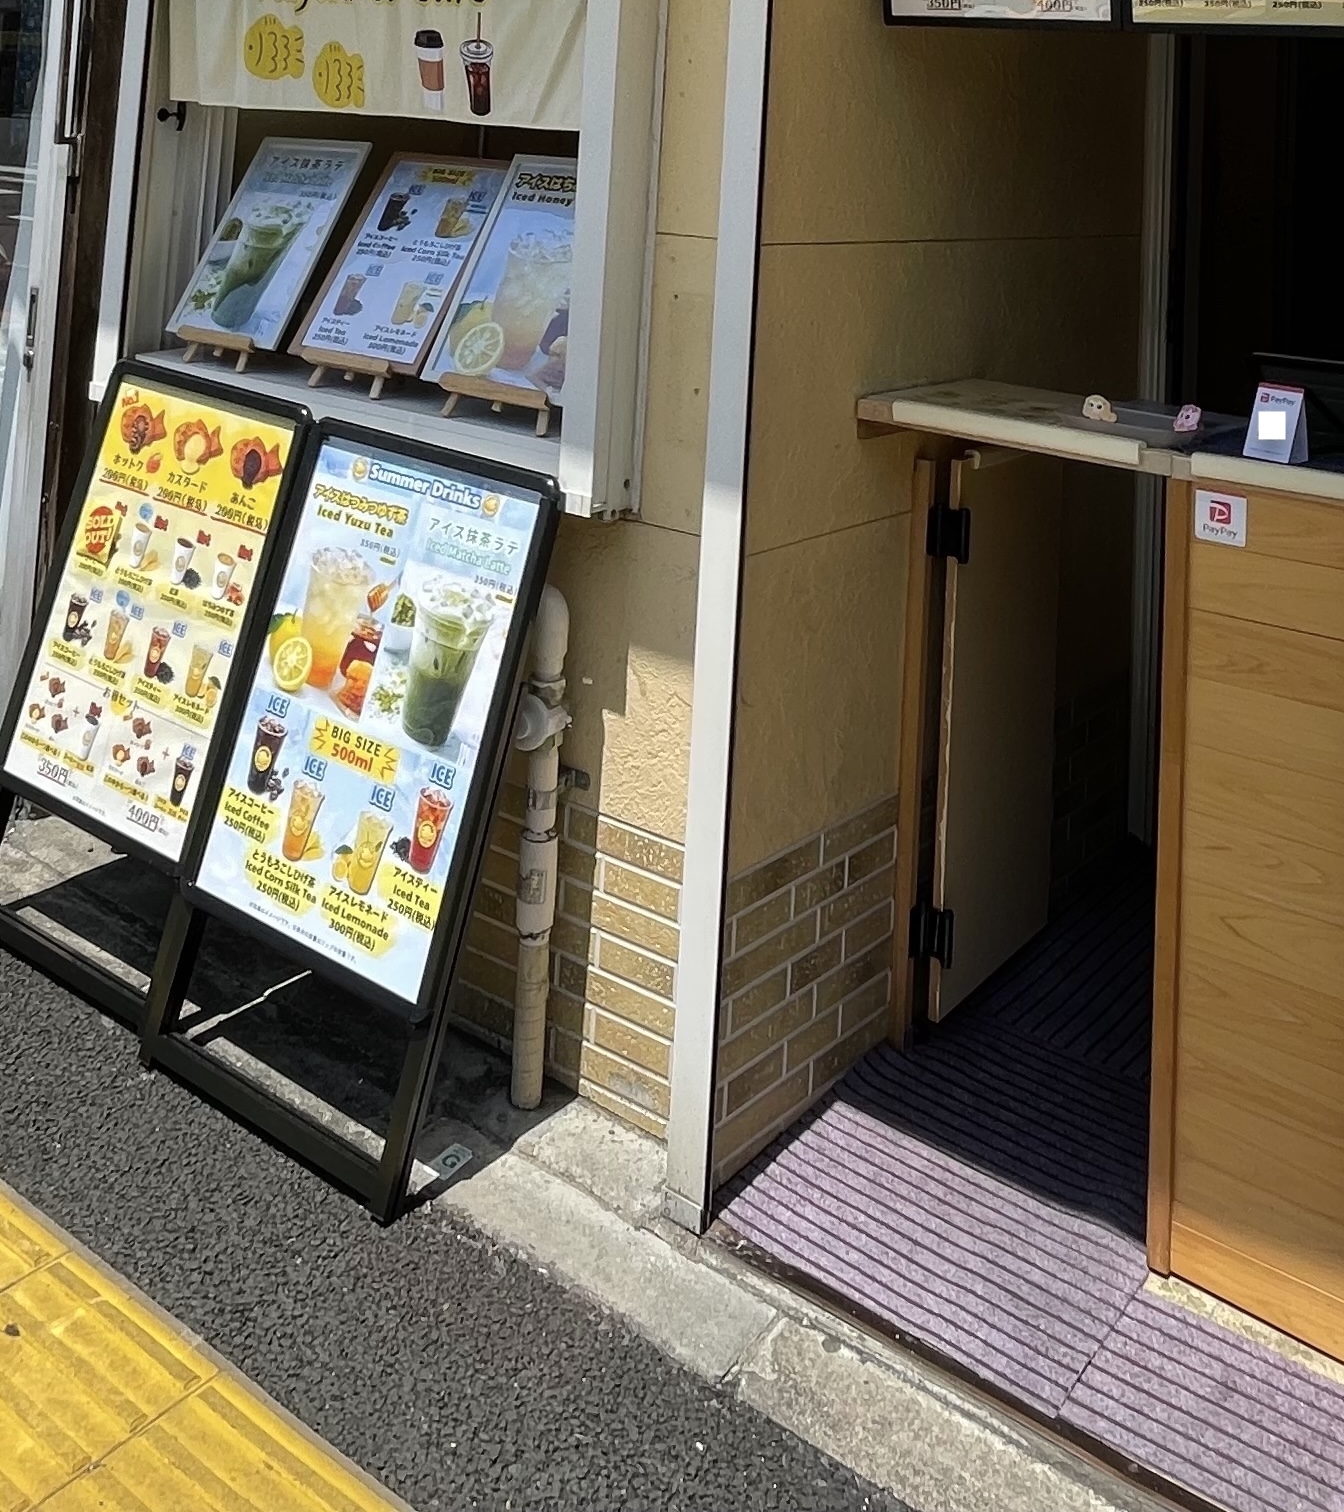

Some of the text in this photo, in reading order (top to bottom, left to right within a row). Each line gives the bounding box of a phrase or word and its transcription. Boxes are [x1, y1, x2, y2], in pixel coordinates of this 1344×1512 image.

[516, 173, 577, 192] アイスはち
[512, 192, 573, 207] Iced Honey
[113, 453, 144, 471] ホットク
[167, 471, 208, 494] カスタード
[369, 463, 482, 510] Summer Drinks
[230, 492, 257, 510] あんこ
[87, 514, 115, 529] SOLD
[317, 504, 394, 538] Iced Yuzu Tea
[1202, 523, 1238, 539] PayPay
[428, 517, 519, 556] アイス抹茶ラテ
[426, 539, 511, 575] Iced Matcha Latte
[268, 695, 289, 716] ICE
[331, 724, 383, 758] BIG SIZE
[305, 756, 326, 778] ICE
[331, 745, 374, 773] 500ml
[432, 763, 454, 787] ICE
[227, 788, 275, 816] アイスコーヒー
[372, 786, 394, 809] ICE
[224, 803, 270, 831] Iced Coffee
[245, 857, 317, 905] Iced Corn Silk Tea
[252, 848, 317, 888] とうもろこしひげ茶
[393, 866, 438, 894] アイスティー
[329, 885, 389, 923] アイスレモネード
[392, 884, 430, 911] Iced Tea
[321, 897, 389, 941] Iced Lemonade
